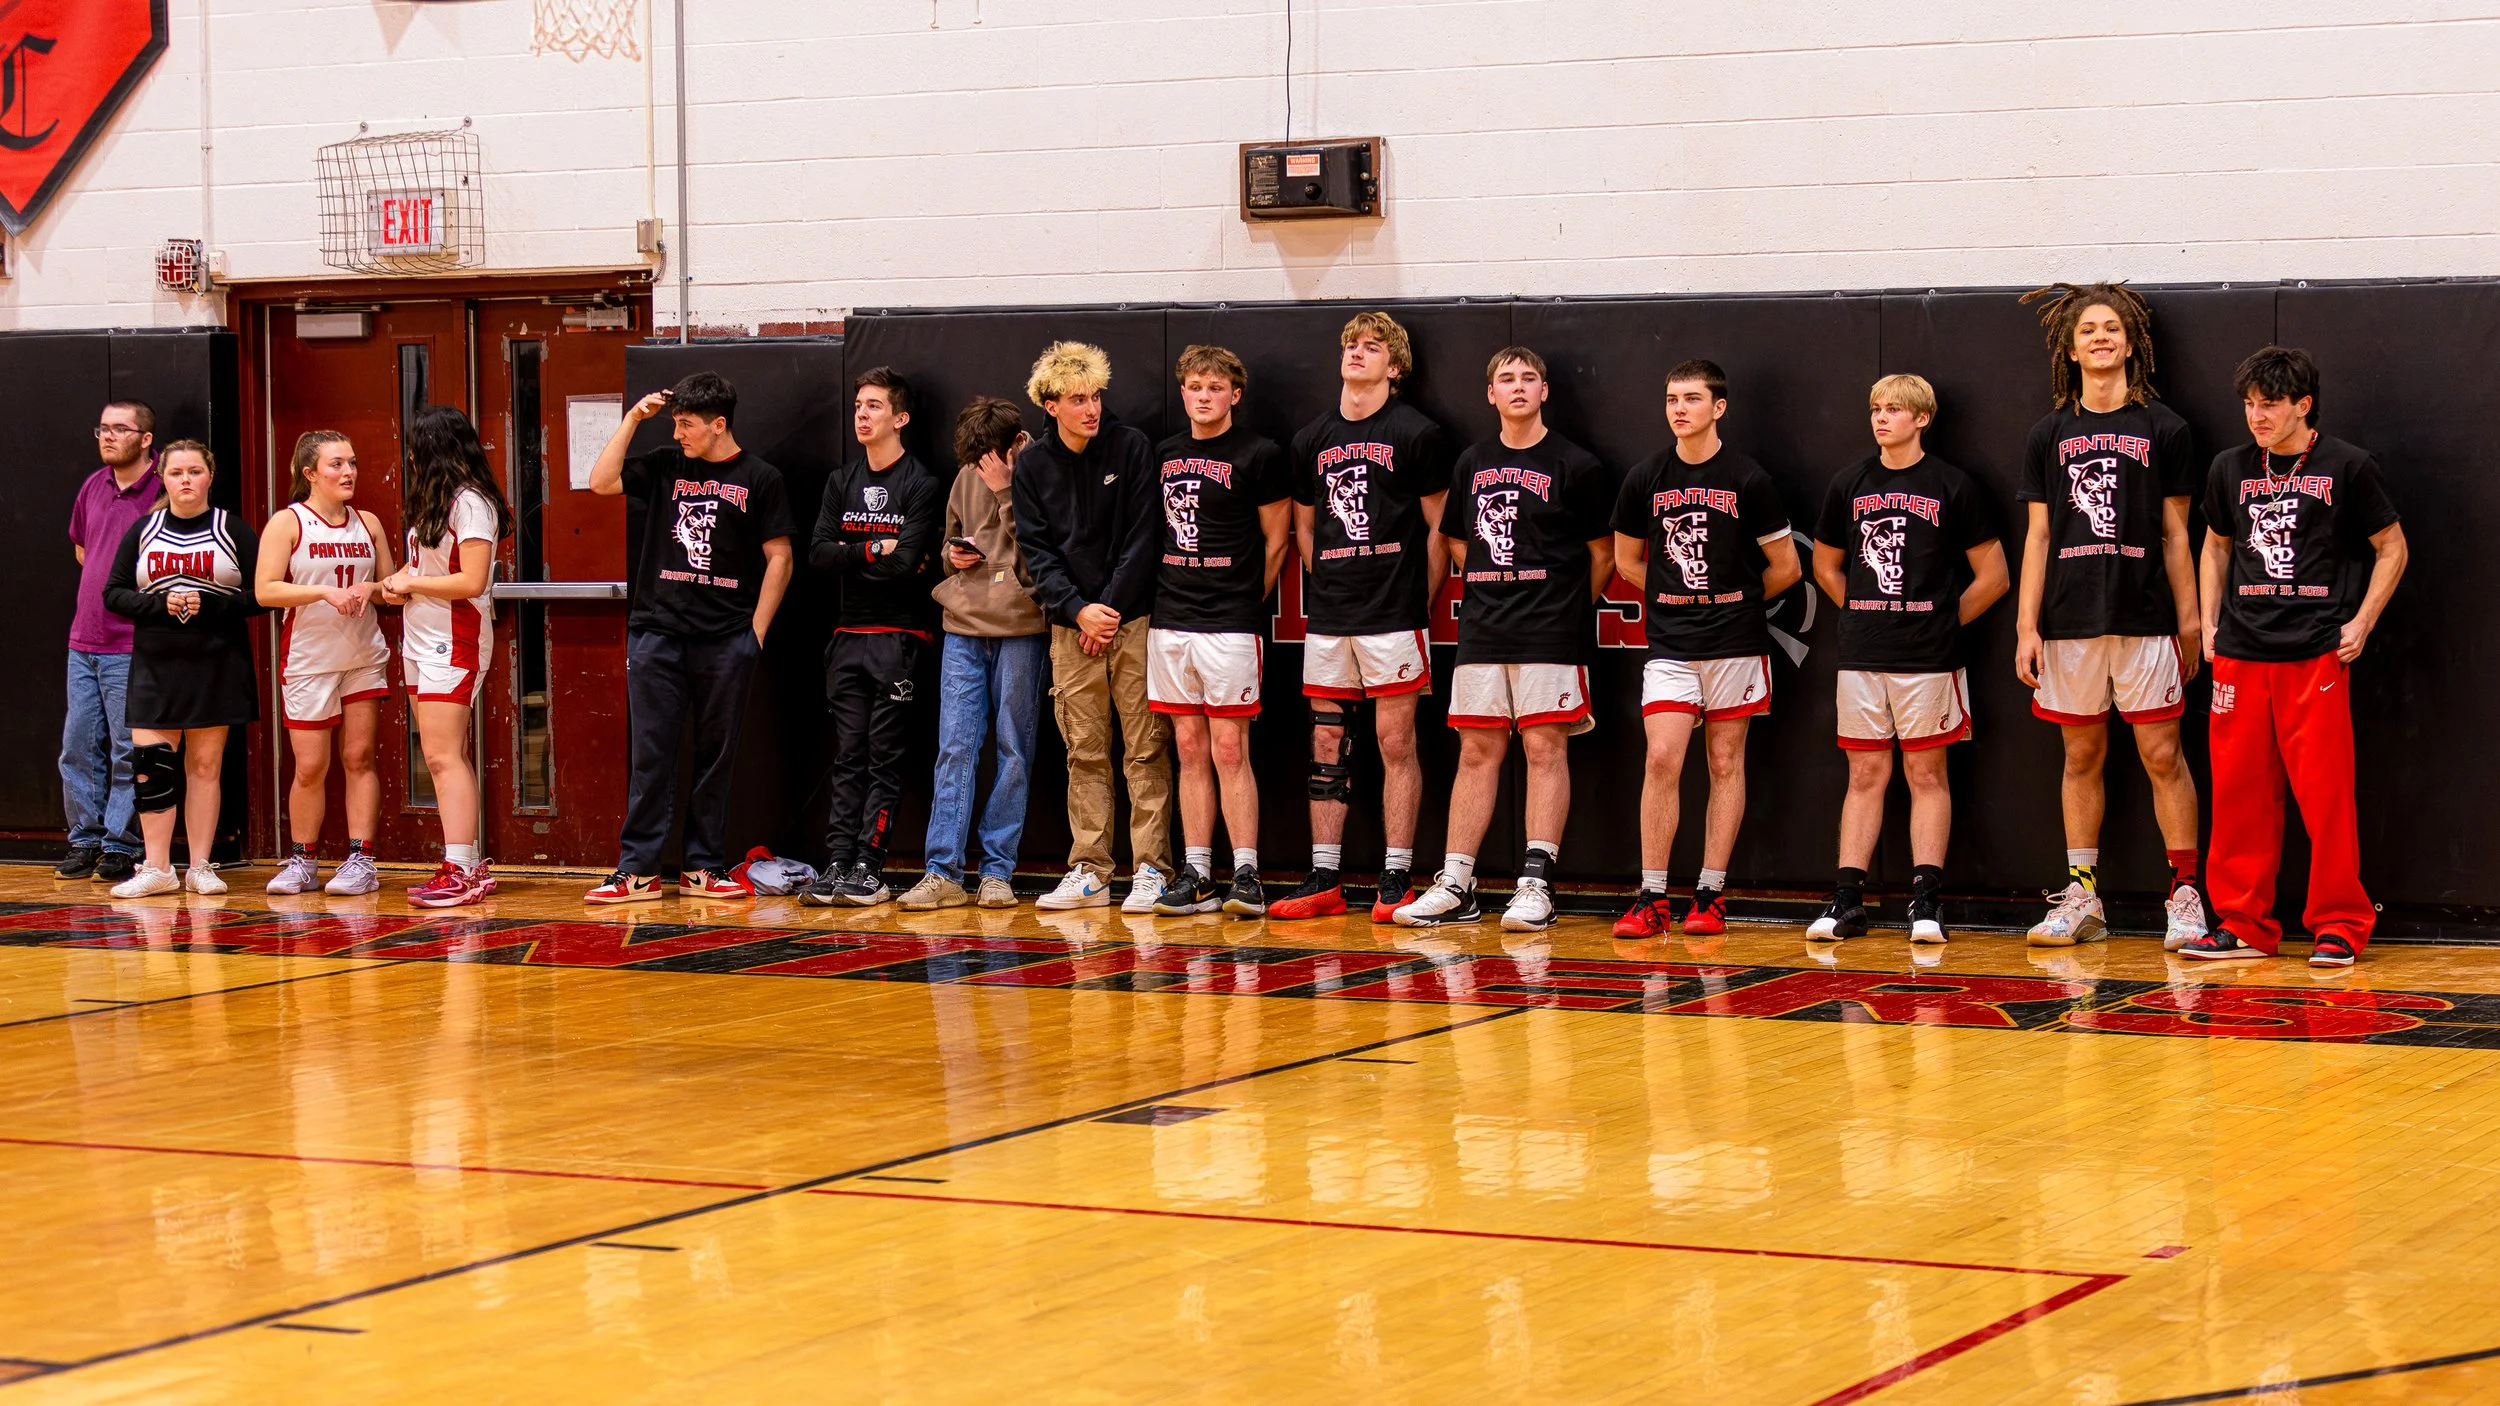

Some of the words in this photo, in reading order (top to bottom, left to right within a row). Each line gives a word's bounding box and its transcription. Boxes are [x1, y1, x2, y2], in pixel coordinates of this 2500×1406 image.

[383, 198, 432, 245] EXIT
[1317, 442, 1394, 475] PANTHER
[2058, 433, 2150, 468] PANTHER
[1160, 458, 1232, 490] PANTHER
[1471, 467, 1551, 502] PANTHER
[2239, 475, 2333, 506] PANTHER
[672, 479, 748, 513] PANTHER
[1353, 464, 1370, 541] PRIDE
[1653, 487, 1739, 519] PANTHER
[1853, 492, 1940, 527] PANTHER
[2102, 457, 2118, 538] PRIDE
[842, 511, 905, 525] CHATHAM
[1184, 480, 1202, 552] PRIDE
[1501, 490, 1519, 566] PRIDE
[309, 542, 371, 559] PANTHERS
[698, 501, 718, 570] PRIDE
[1692, 511, 1709, 590] PRIDE
[2058, 544, 2104, 559] JANUARY
[2278, 498, 2299, 579] PRIDE
[147, 550, 215, 583] CHATHAM
[1888, 516, 1907, 595] PRIDE
[334, 564, 355, 588] 11
[2221, 684, 2235, 694] AS
